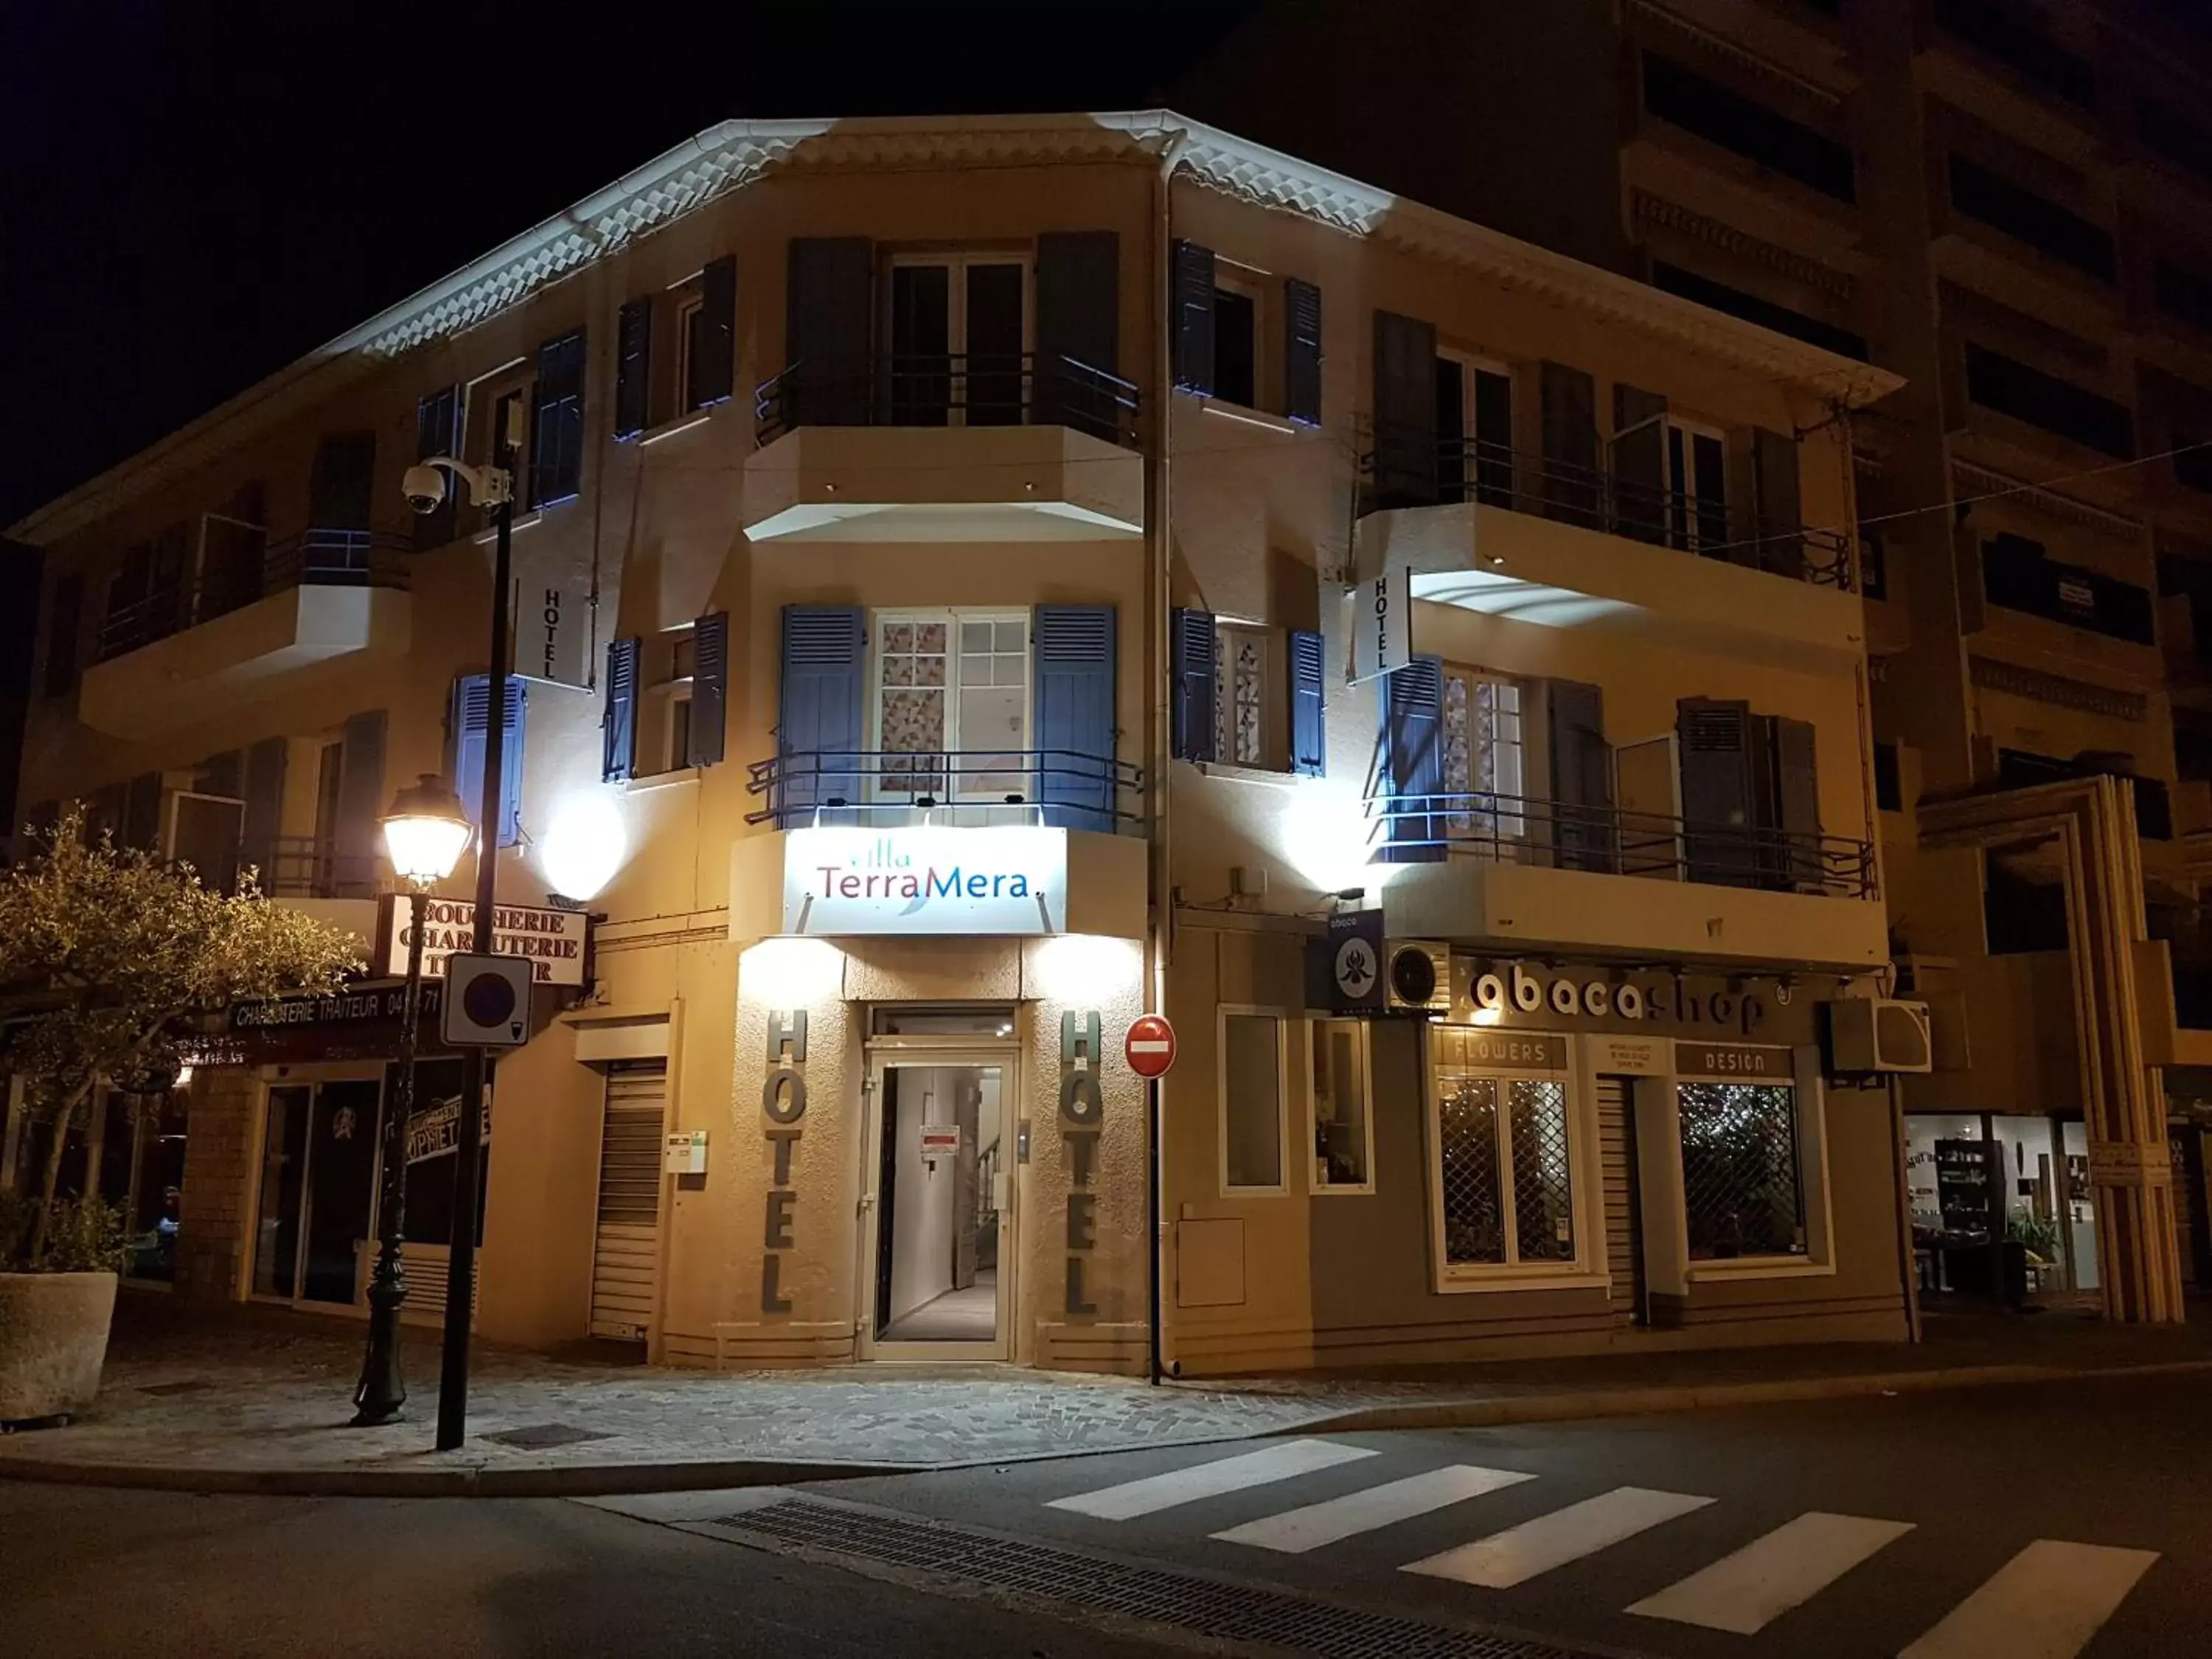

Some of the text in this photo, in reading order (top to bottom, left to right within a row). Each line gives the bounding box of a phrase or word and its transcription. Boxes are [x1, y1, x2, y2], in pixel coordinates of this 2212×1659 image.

[544, 589, 559, 678] HOTEL
[1374, 577, 1388, 669] HOTEL
[424, 902, 565, 933] BOUHERIE
[399, 925, 577, 959] CHARUTERIE
[236, 1000, 316, 1026] CHARUTERIE
[319, 995, 380, 1020] TRAITEUR
[1455, 1040, 1546, 1062] FLOWERS
[1705, 1052, 1764, 1071] DESIGN
[761, 1009, 808, 1313] HOTEL
[1060, 1010, 1103, 1315] HOTEL
